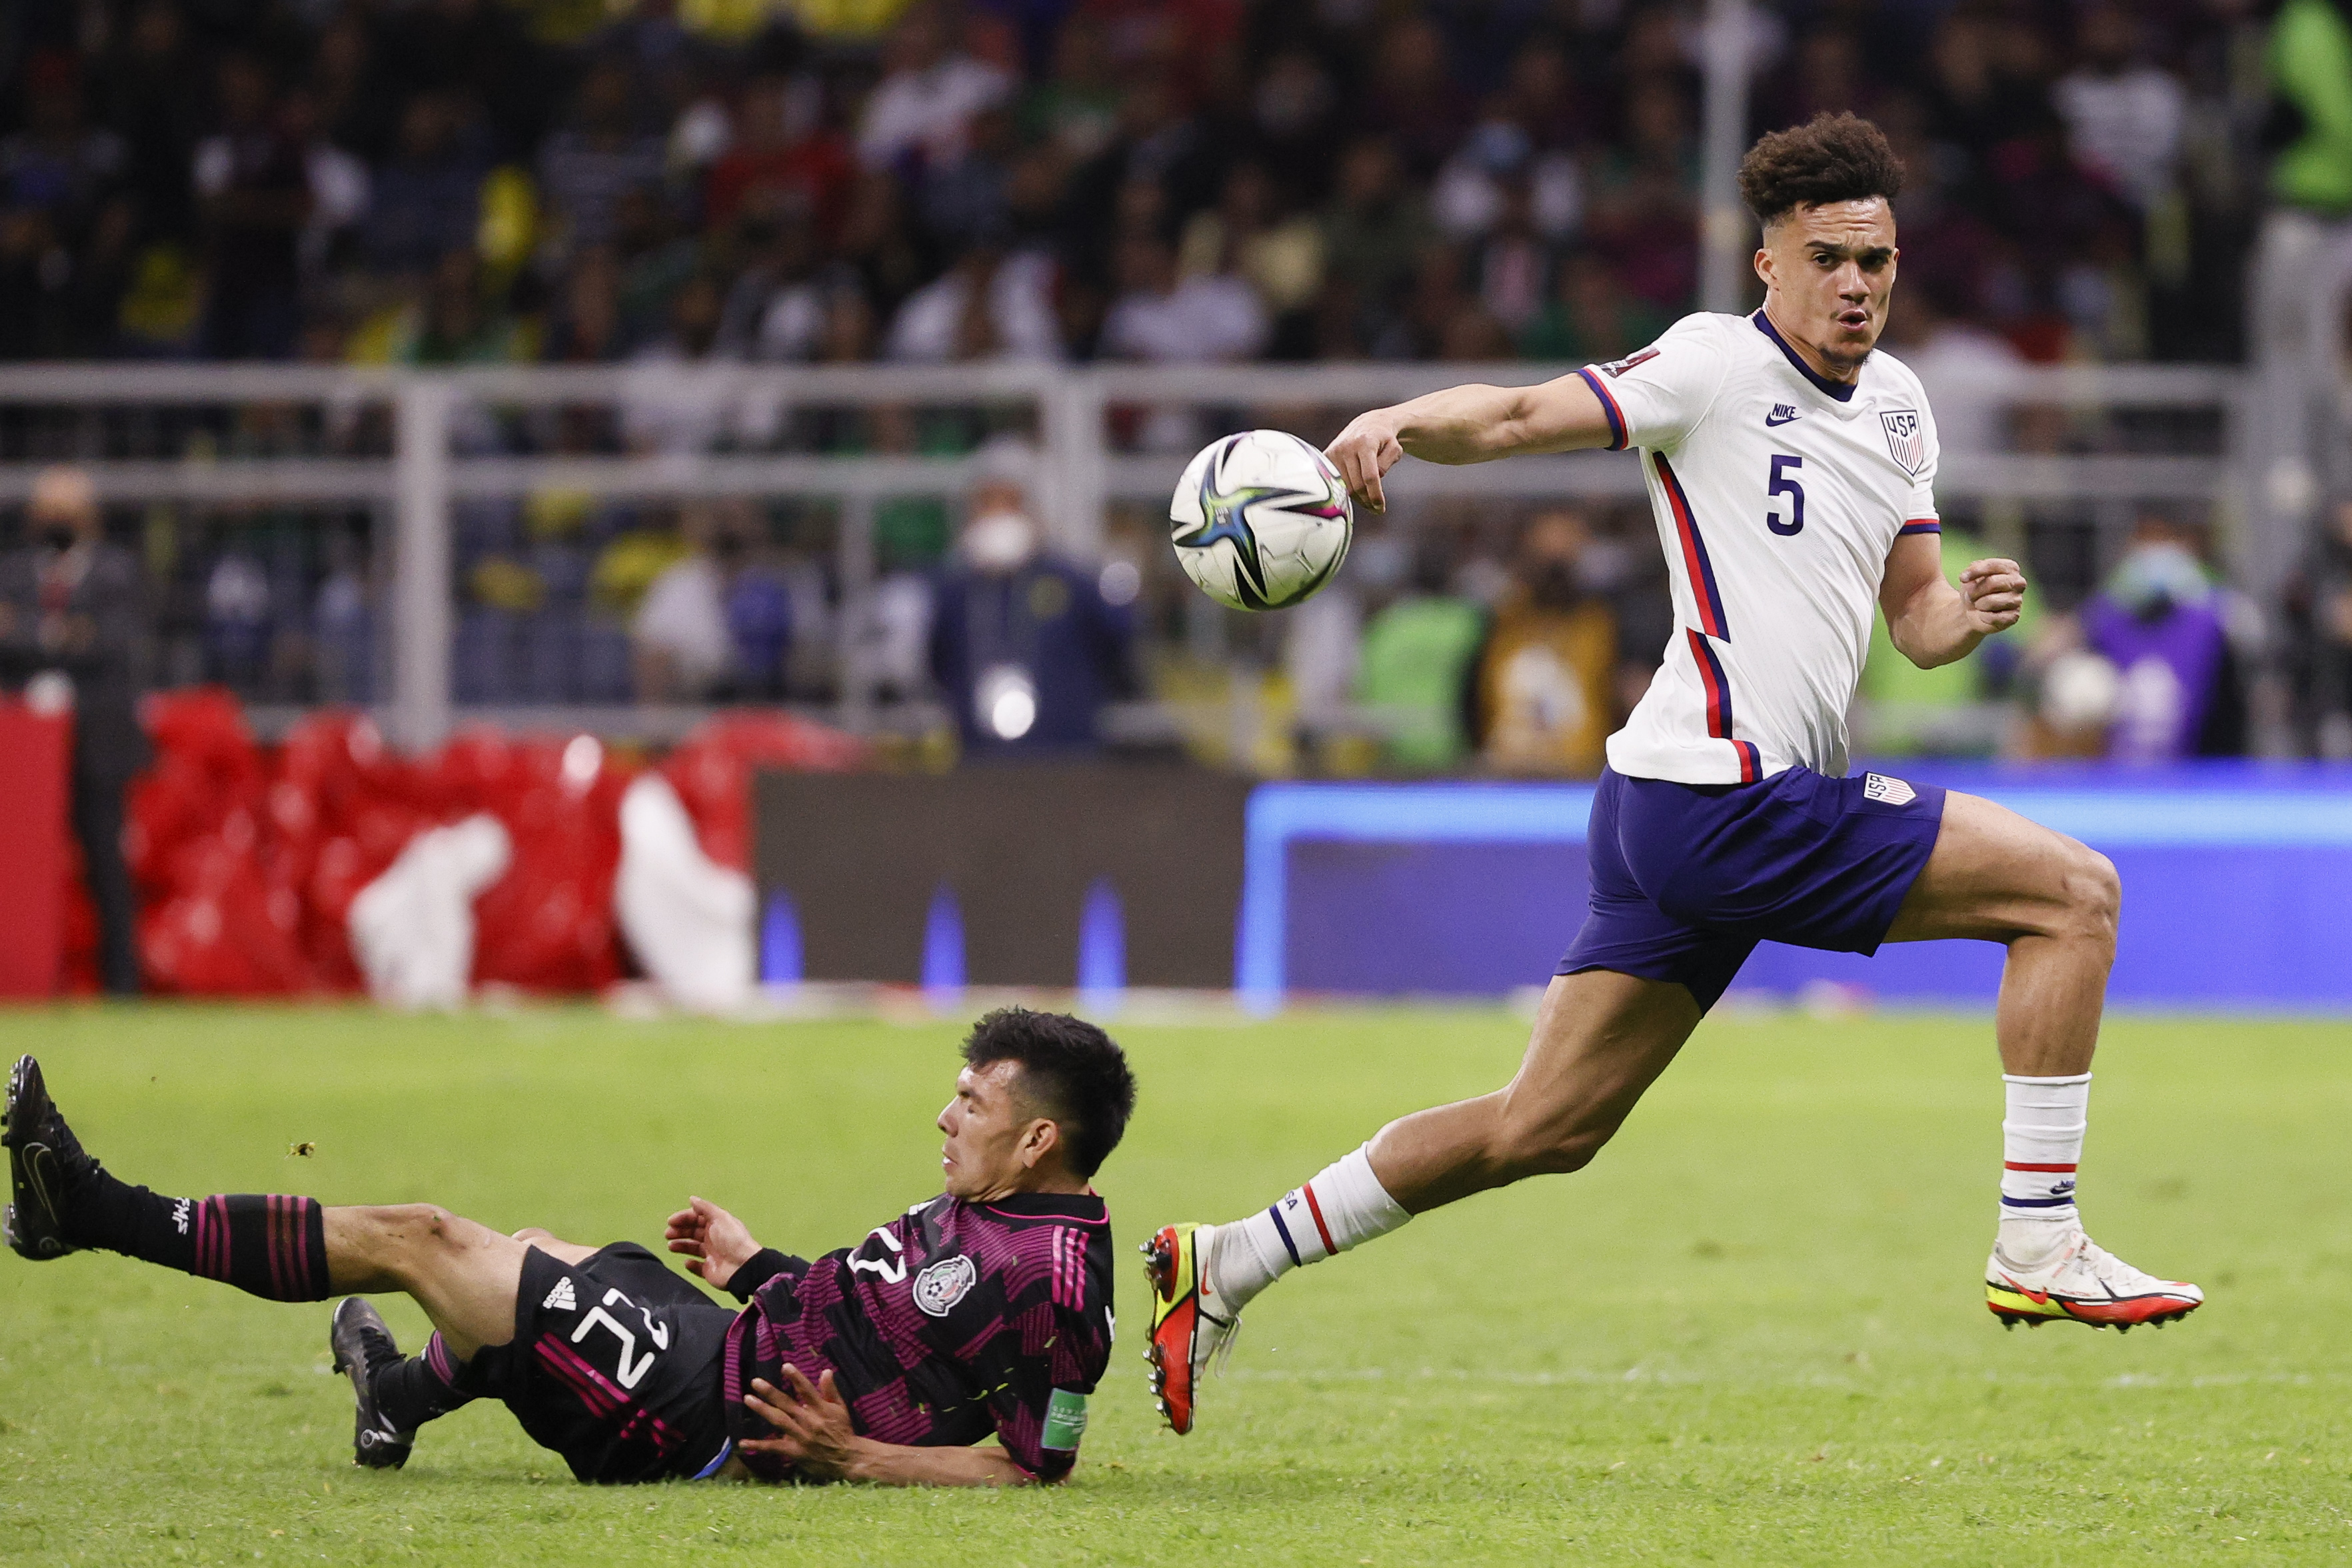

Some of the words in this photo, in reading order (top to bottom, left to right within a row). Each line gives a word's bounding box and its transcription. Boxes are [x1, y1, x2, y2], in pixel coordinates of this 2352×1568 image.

[1771, 402, 1796, 419] NIKE
[1885, 414, 1917, 438] USA
[1766, 454, 1805, 536] 5
[1867, 774, 1887, 798] USA
[1284, 1189, 1298, 1211] SA
[542, 1275, 571, 1309] adidas
[571, 1287, 669, 1390] 22
